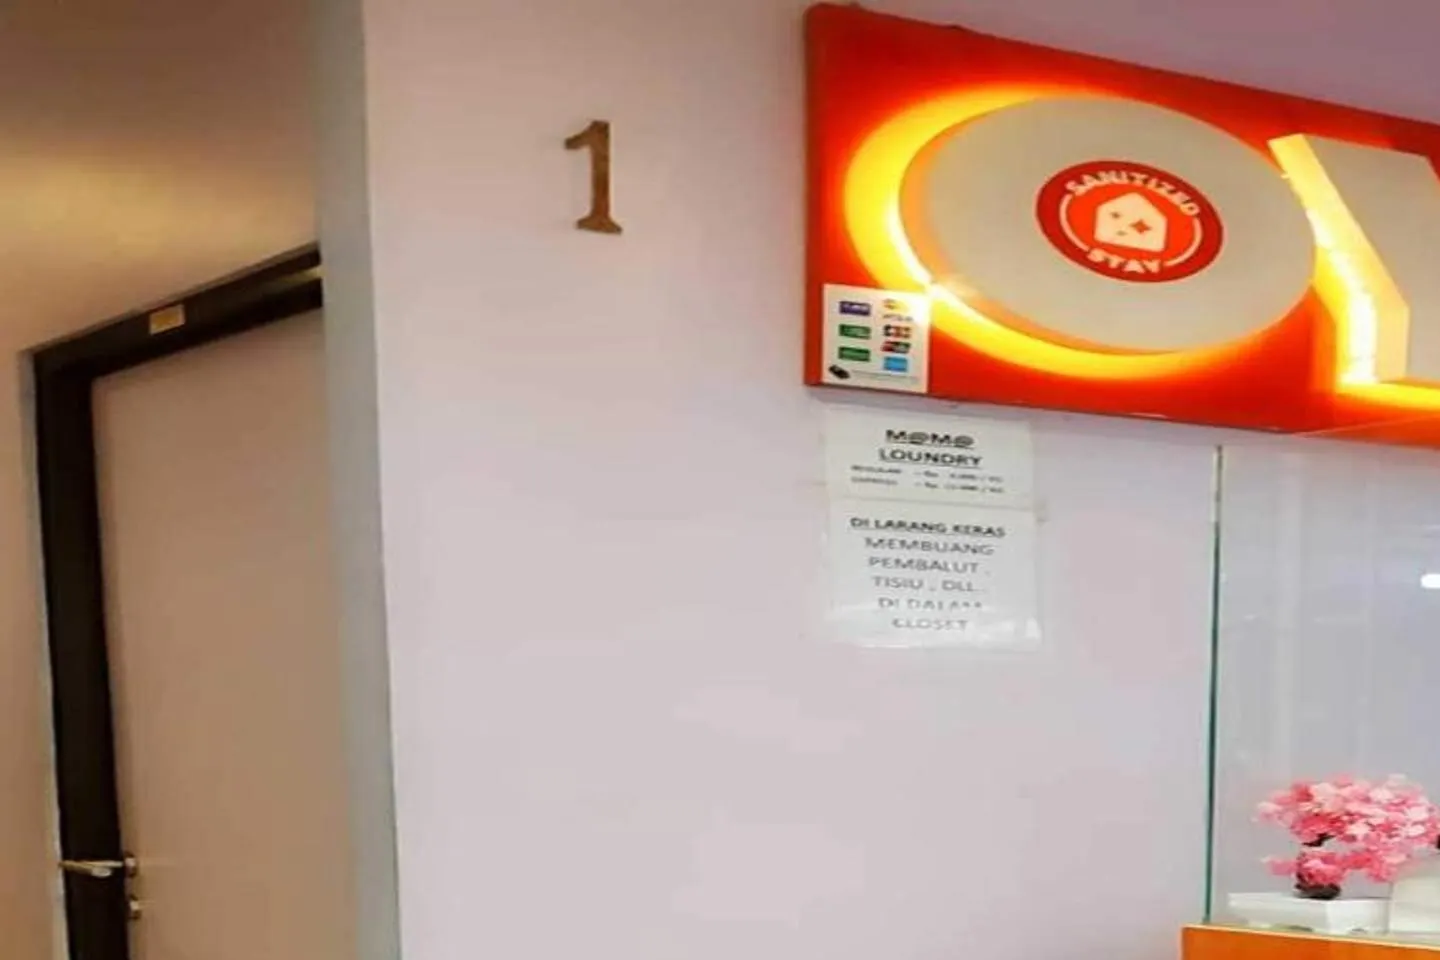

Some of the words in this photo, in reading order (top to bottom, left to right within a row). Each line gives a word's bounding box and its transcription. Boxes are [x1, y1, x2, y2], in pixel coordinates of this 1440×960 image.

[564, 120, 623, 235] 1
[1065, 170, 1200, 217] SANITIZED
[1087, 248, 1162, 274] STAY
[878, 448, 983, 467] LOUNDRY
[874, 518, 948, 534] LARANG
[952, 523, 1006, 538] KERAS
[864, 537, 995, 556] MEMBUANG
[868, 555, 979, 574] PEMBALUT
